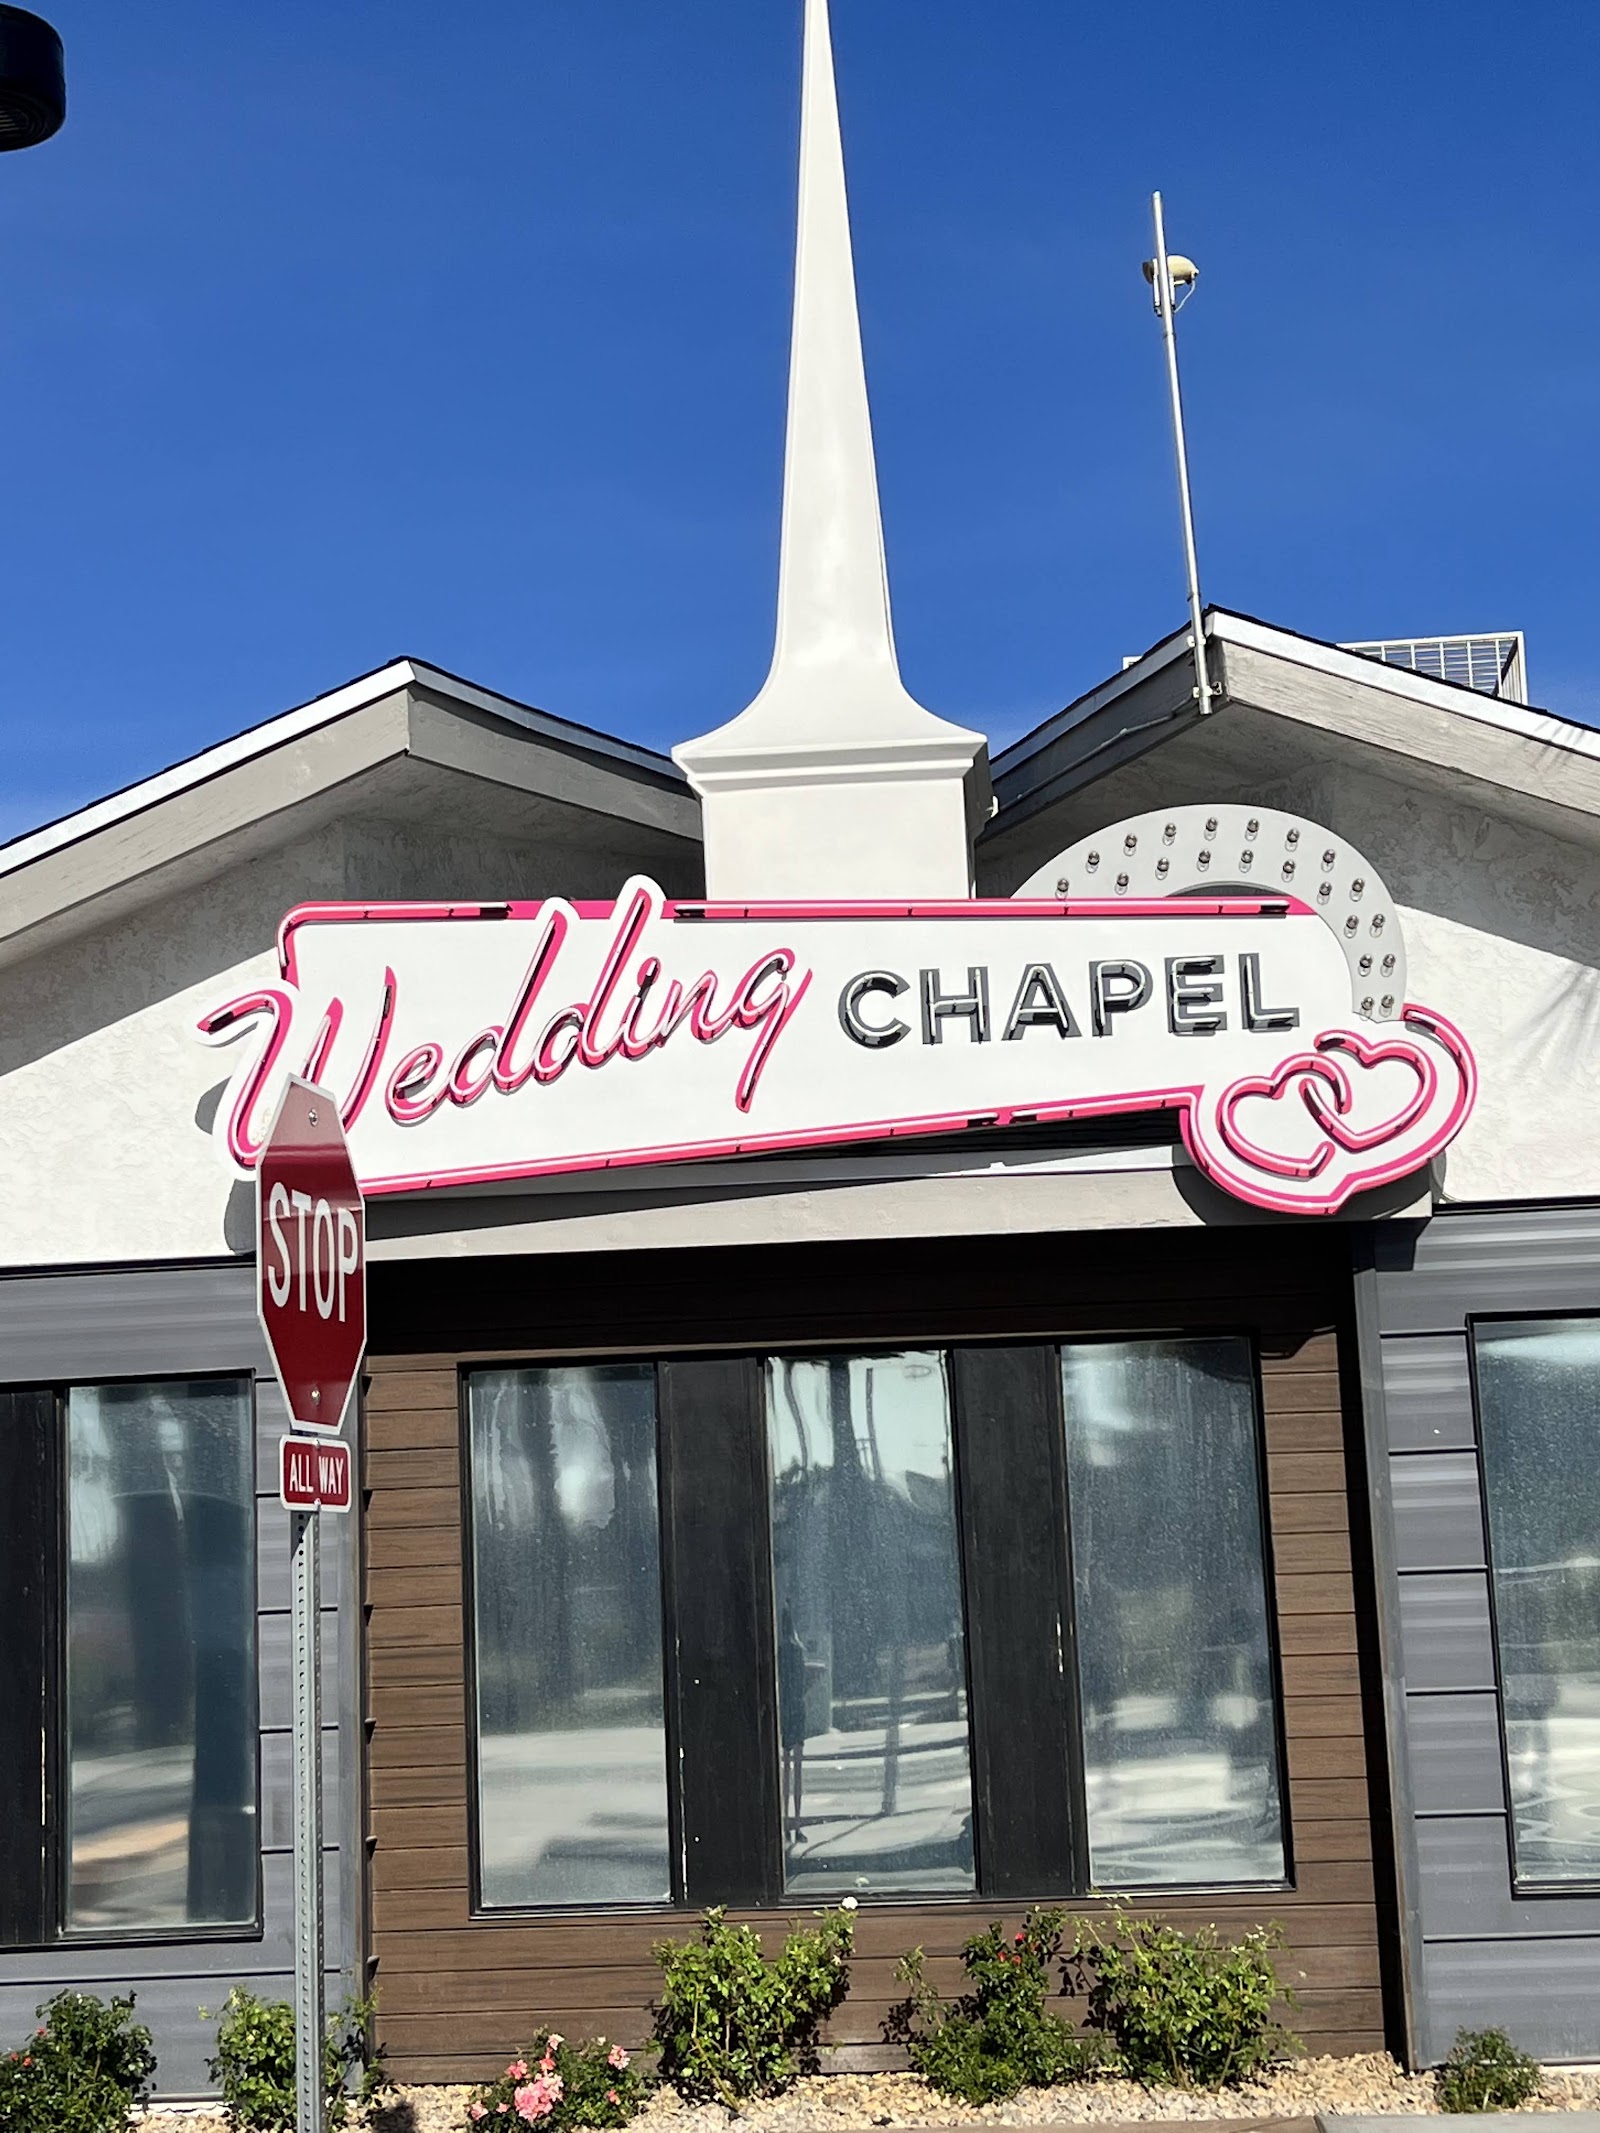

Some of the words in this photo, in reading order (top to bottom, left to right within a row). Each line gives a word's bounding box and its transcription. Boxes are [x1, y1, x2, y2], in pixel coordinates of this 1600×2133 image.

[198, 887, 813, 1168] Wedding
[838, 952, 1300, 1049] CHAPEL
[268, 1182, 359, 1322] STOP
[289, 1453, 314, 1493] ALL
[318, 1455, 344, 1495] WAY
